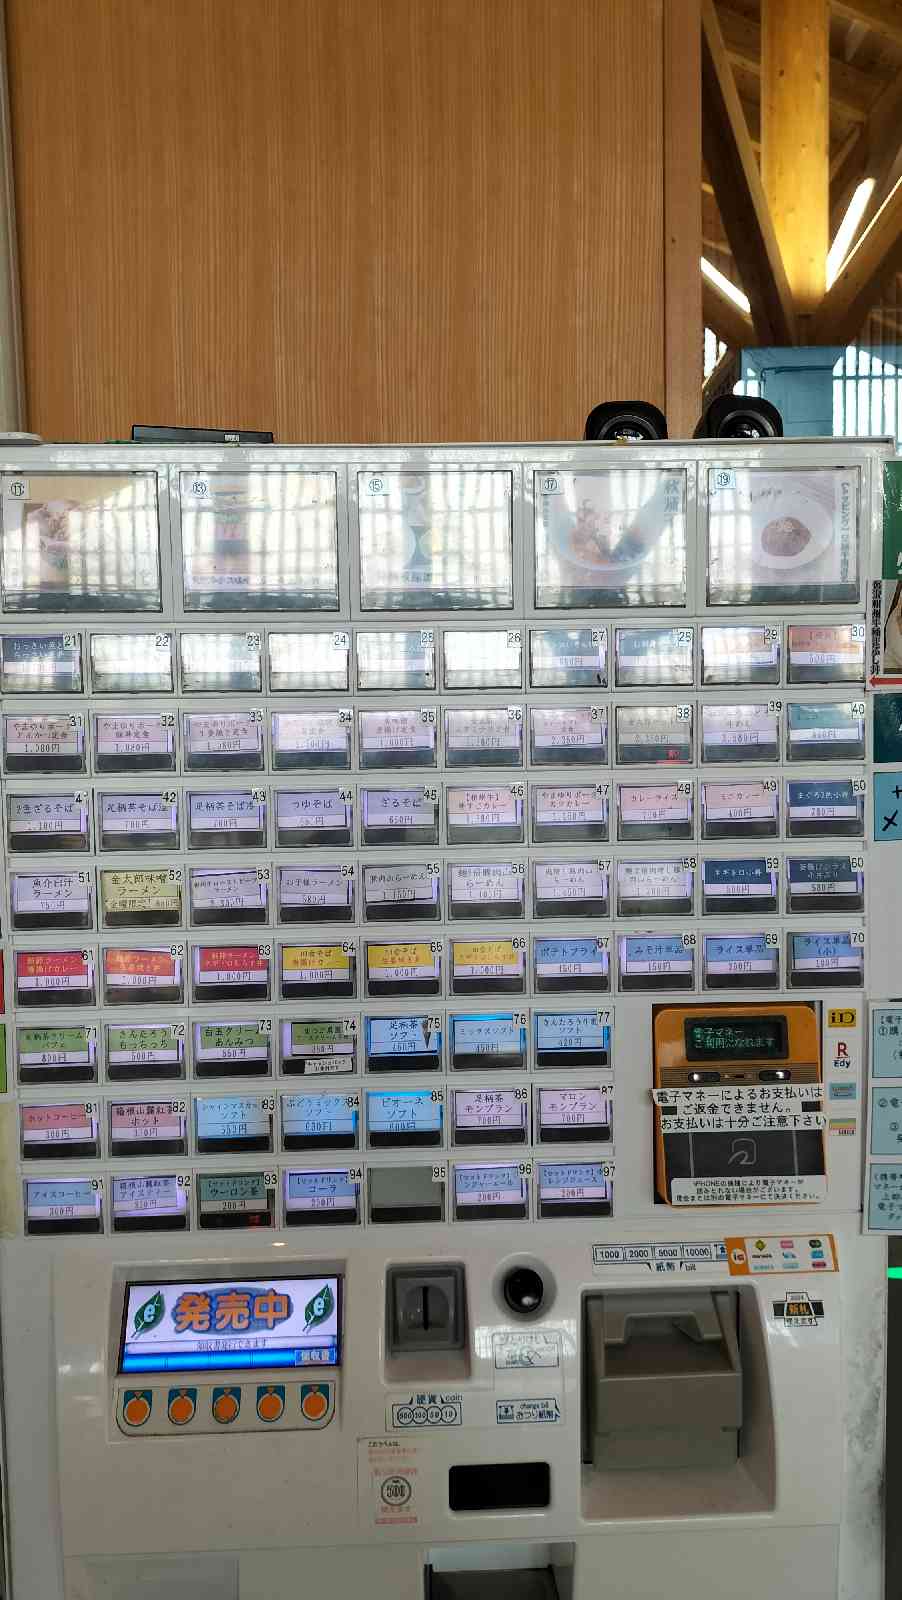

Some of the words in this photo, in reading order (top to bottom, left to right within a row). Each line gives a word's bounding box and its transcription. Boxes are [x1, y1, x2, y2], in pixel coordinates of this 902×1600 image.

[592, 630, 605, 642] 27
[765, 628, 777, 640] 29
[852, 626, 865, 637] 30
[64, 635, 77, 647] 21
[155, 635, 169, 647] 22
[334, 635, 346, 646] 24
[508, 632, 521, 643] 26
[769, 702, 782, 712] 39
[852, 703, 864, 714] 40
[249, 712, 262, 722] 33
[339, 712, 352, 723] 34
[422, 712, 435, 722] 35
[508, 709, 522, 720] 36
[592, 709, 605, 719] 37
[677, 708, 689, 718] 38
[70, 716, 82, 727] 31
[162, 716, 175, 727] 32
[511, 786, 524, 796] 46
[678, 783, 690, 793] 48
[763, 781, 776, 791] 49
[853, 781, 865, 791] 50
[162, 793, 175, 801] 42
[253, 791, 265, 801] 43
[340, 791, 352, 800] 44
[424, 790, 437, 800] 45
[599, 861, 610, 870] 57
[683, 859, 696, 868] 58
[767, 859, 778, 868] 59
[852, 859, 863, 867] 60
[342, 866, 354, 875] 54
[428, 864, 439, 873] 55
[512, 864, 525, 873] 56
[79, 873, 90, 882] 51
[169, 872, 182, 881] 52
[258, 870, 269, 879] 53
[33, 889, 72, 897] ラーメン
[117, 886, 159, 896] ラーメン
[683, 935, 695, 944] 68
[766, 935, 778, 943] 69
[853, 933, 864, 942] 70
[343, 943, 355, 952] 64
[513, 939, 525, 947] 66
[83, 950, 93, 960] 61
[170, 946, 183, 955] 62
[258, 946, 270, 955] 63
[514, 1014, 526, 1024] 76
[599, 1012, 610, 1021] 77
[831, 1011, 855, 1024] iD
[260, 1019, 271, 1029] 73
[344, 1020, 355, 1029] 74
[429, 1018, 440, 1027] 75
[86, 1028, 96, 1037] 71
[172, 1026, 185, 1035] 72
[834, 1060, 850, 1068] Edy
[432, 1092, 443, 1101] 85
[515, 1089, 527, 1099] 86
[656, 1087, 823, 1104] 電子マネーによるお支払いは
[262, 1100, 274, 1109] 83
[348, 1097, 359, 1106] 84
[172, 1103, 185, 1112] 82
[464, 1104, 513, 1113] モンブラン
[548, 1103, 596, 1112] モンブラン
[682, 1102, 791, 1115] ご返金できません。
[387, 1109, 417, 1119] ソフト
[661, 1115, 827, 1130] お支払いは十分ご注意下さい
[350, 1168, 361, 1179] 94
[433, 1167, 445, 1177] 95
[519, 1164, 532, 1174] 96
[604, 1166, 615, 1176] 97
[178, 1176, 190, 1186] 92
[265, 1174, 277, 1185] 93
[92, 1180, 103, 1190] 91
[309, 1185, 336, 1193] コーラ
[599, 1250, 620, 1259] 1000
[629, 1249, 649, 1258] 2000
[685, 1248, 710, 1257] 10000
[174, 1288, 290, 1332] 発売中
[445, 1394, 463, 1402] coin
